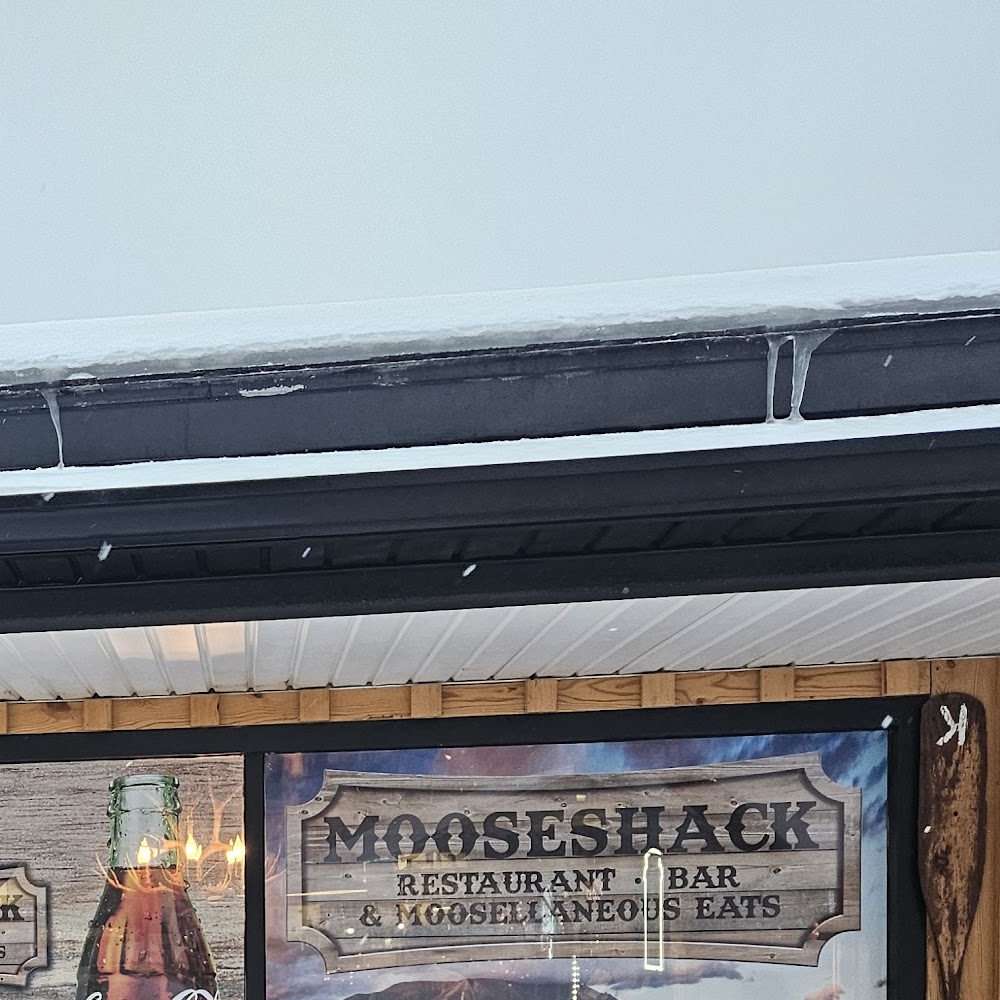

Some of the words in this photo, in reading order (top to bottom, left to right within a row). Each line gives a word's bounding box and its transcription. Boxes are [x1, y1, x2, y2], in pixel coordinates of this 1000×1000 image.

[323, 801, 819, 863] MOOSESHACK
[397, 868, 616, 896] RESTAURANT
[668, 865, 740, 891] BAR
[359, 904, 382, 927] &
[396, 897, 681, 927] MOOSELLANEOUS
[695, 895, 782, 920] EATS
